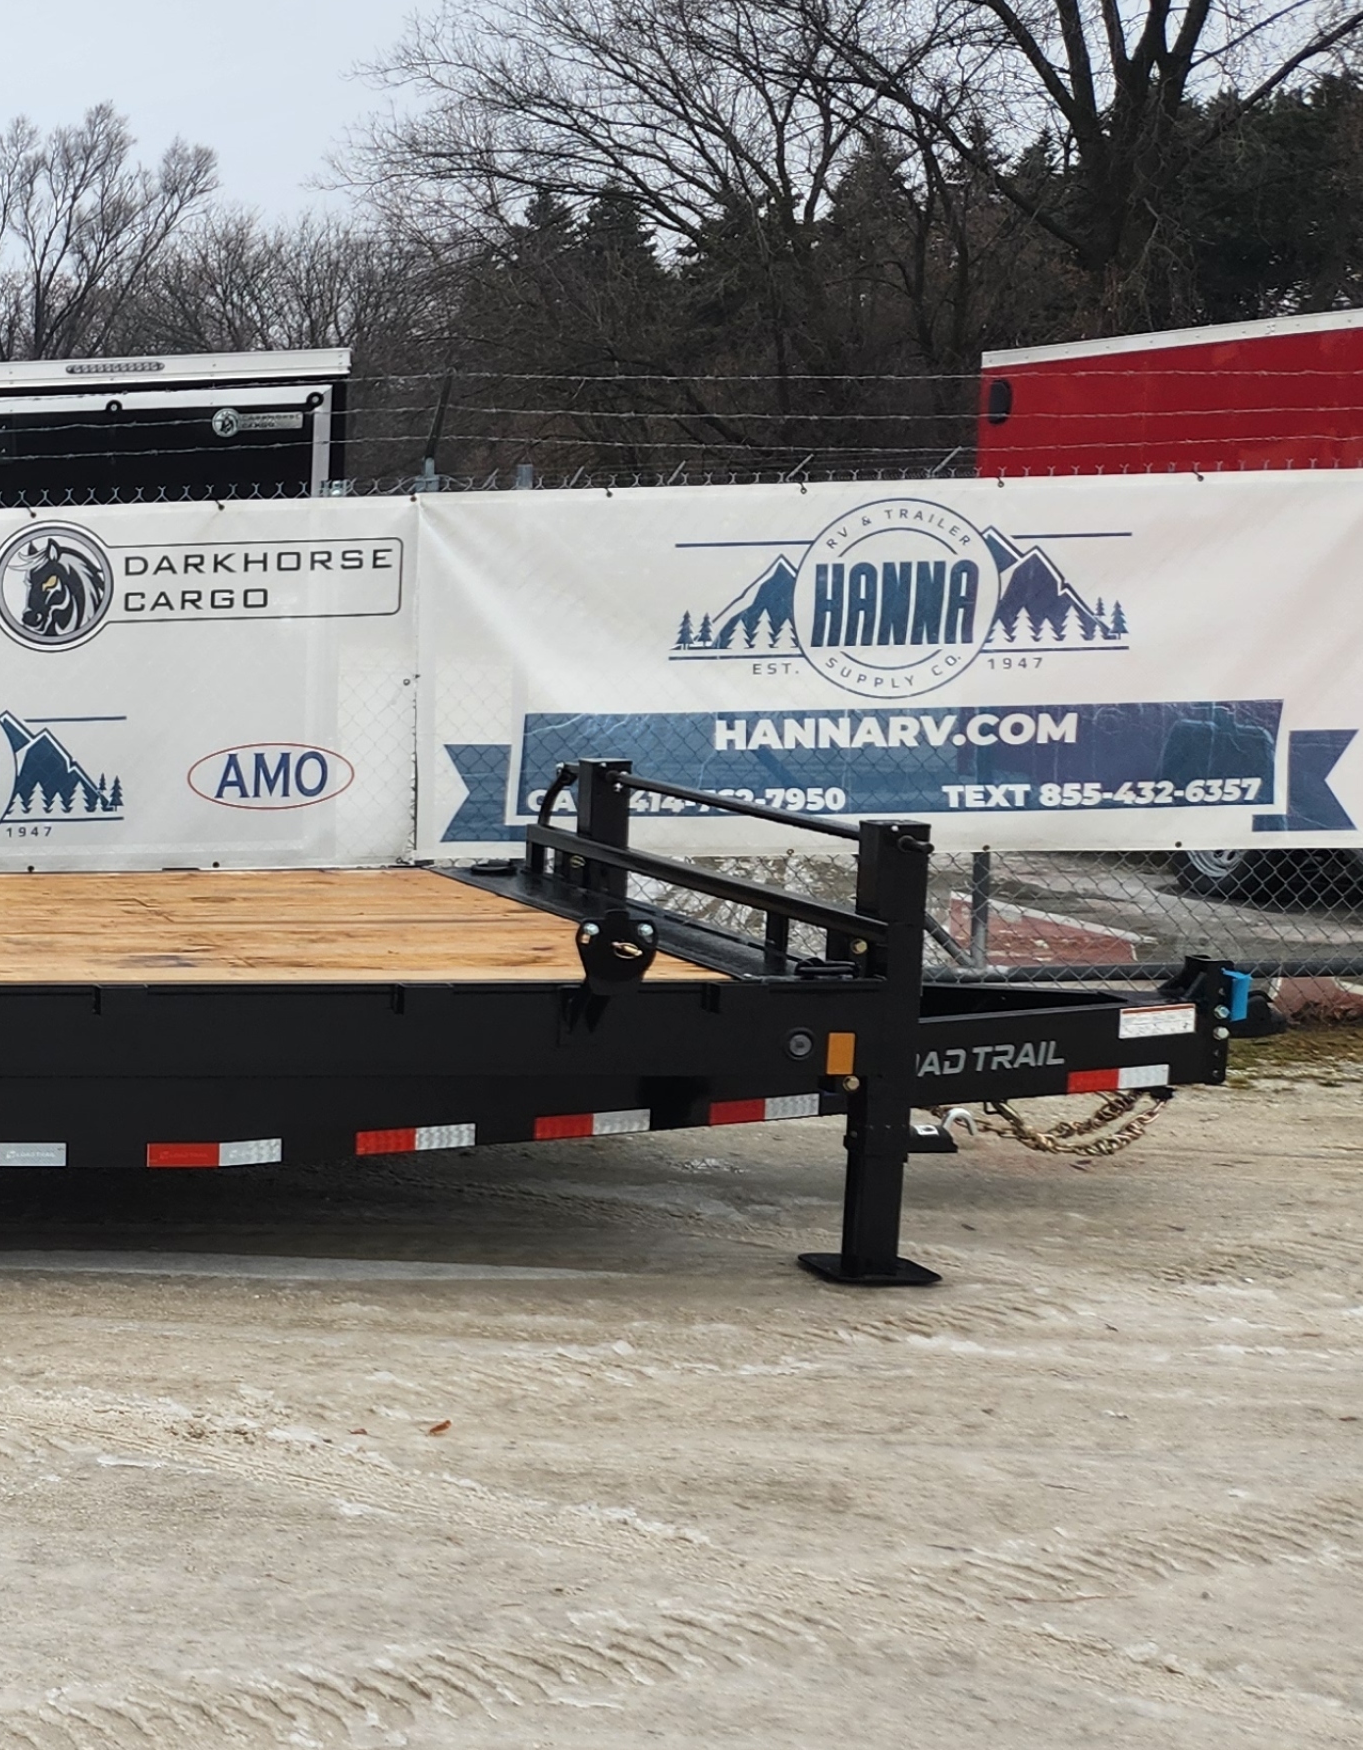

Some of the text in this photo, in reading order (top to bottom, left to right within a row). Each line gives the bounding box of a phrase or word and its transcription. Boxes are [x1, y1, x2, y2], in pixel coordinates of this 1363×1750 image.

[826, 508, 972, 550] RV & TRAILER
[124, 548, 394, 577] DARKHORSE
[123, 587, 269, 613] CARGO
[810, 559, 979, 648] HANNA
[752, 656, 1045, 675] EST. 1947
[824, 654, 963, 689] SUPPLY CO.
[714, 711, 1079, 751] HANNARV.COM
[213, 750, 329, 799] AMO
[941, 777, 1263, 809] TEXT 855-432-6357
[6, 826, 53, 838] 1947
[916, 1040, 1066, 1078] AD TRAIL
